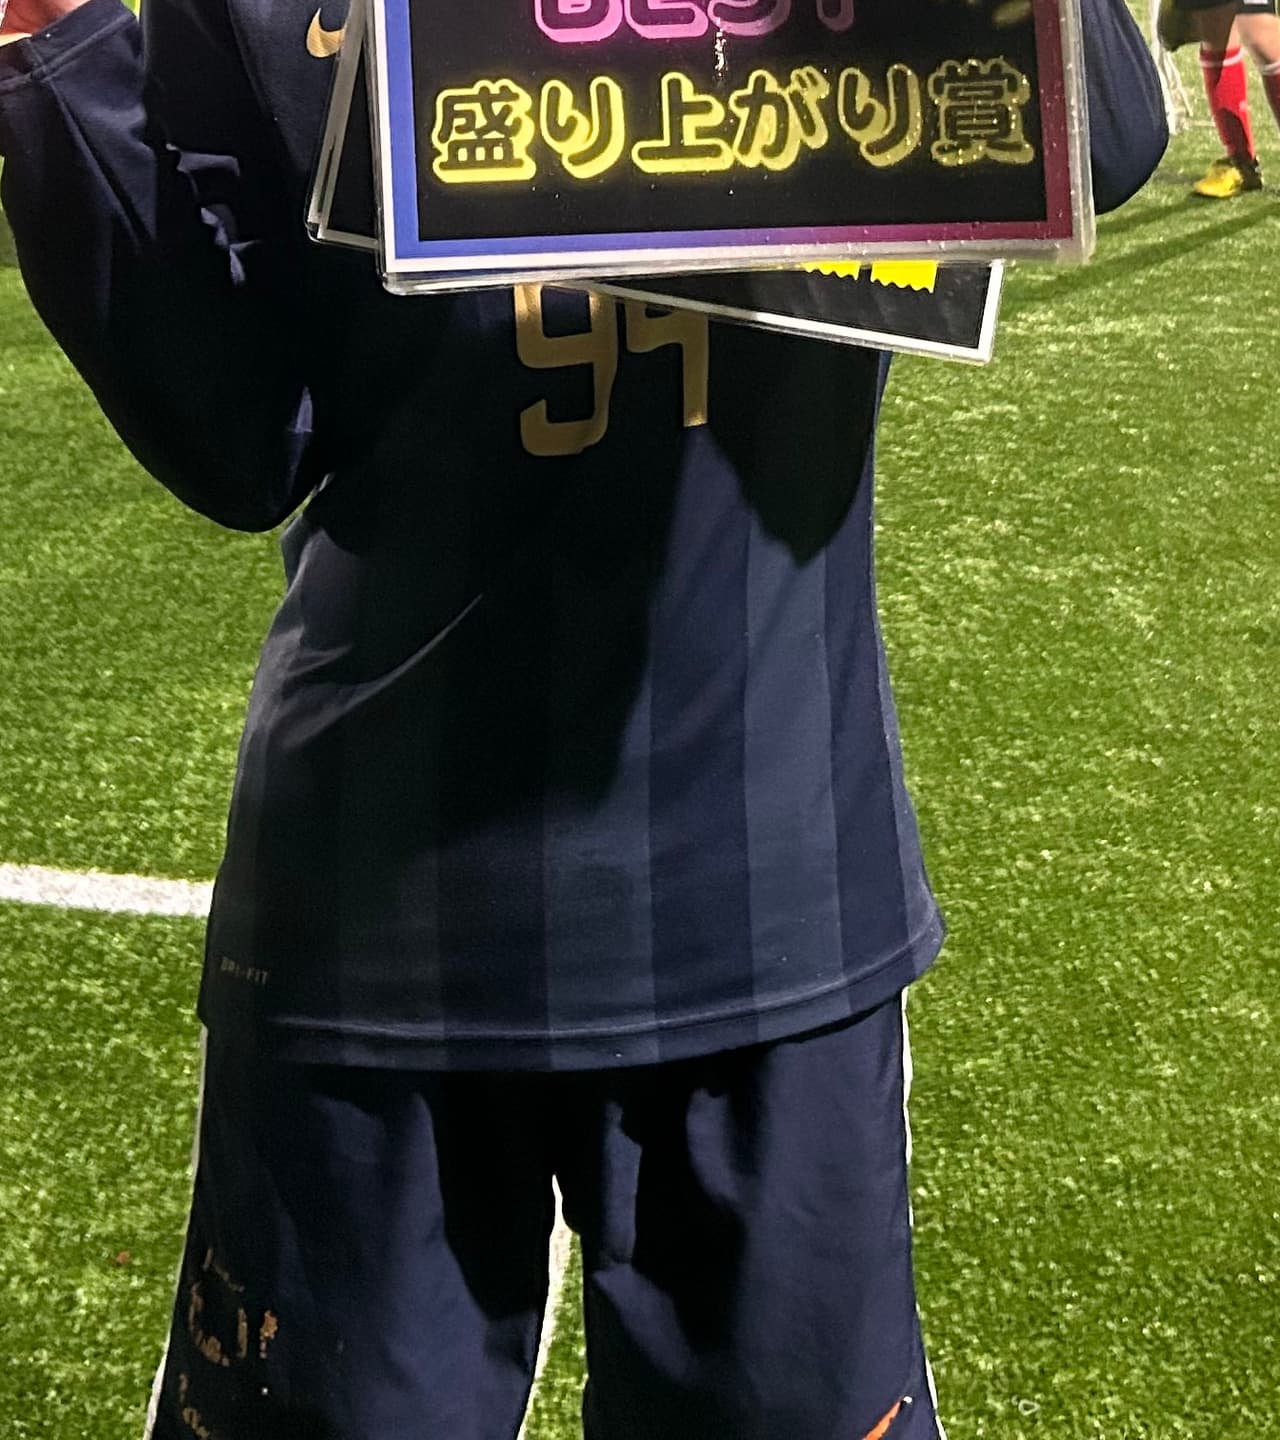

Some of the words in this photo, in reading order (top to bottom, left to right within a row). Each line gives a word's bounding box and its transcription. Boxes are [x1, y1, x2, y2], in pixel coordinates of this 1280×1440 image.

[432, 58, 1035, 182] 盛り上がり賞
[514, 280, 709, 456] 94
